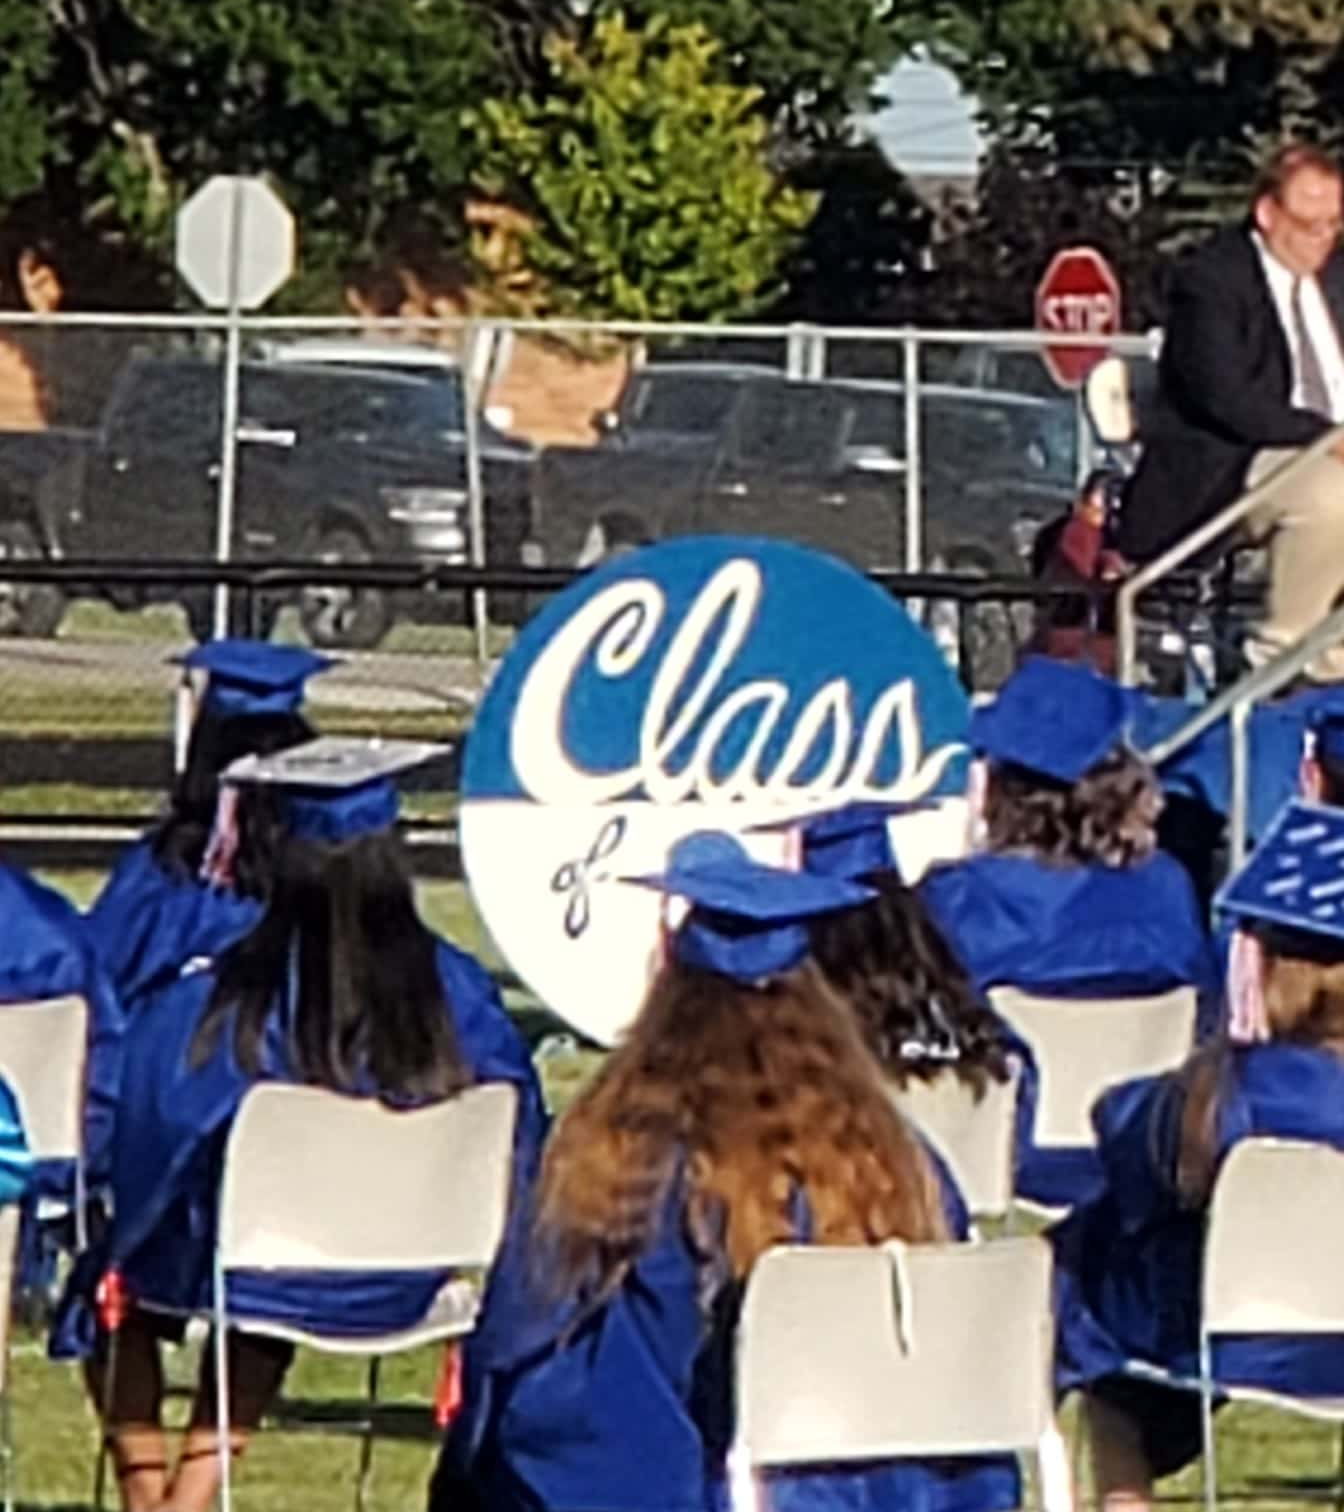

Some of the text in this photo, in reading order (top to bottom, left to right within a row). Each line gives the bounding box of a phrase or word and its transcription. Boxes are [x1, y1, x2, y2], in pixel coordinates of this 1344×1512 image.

[1044, 292, 1113, 333] STOP
[510, 558, 972, 805] Class
[551, 815, 628, 939] of
